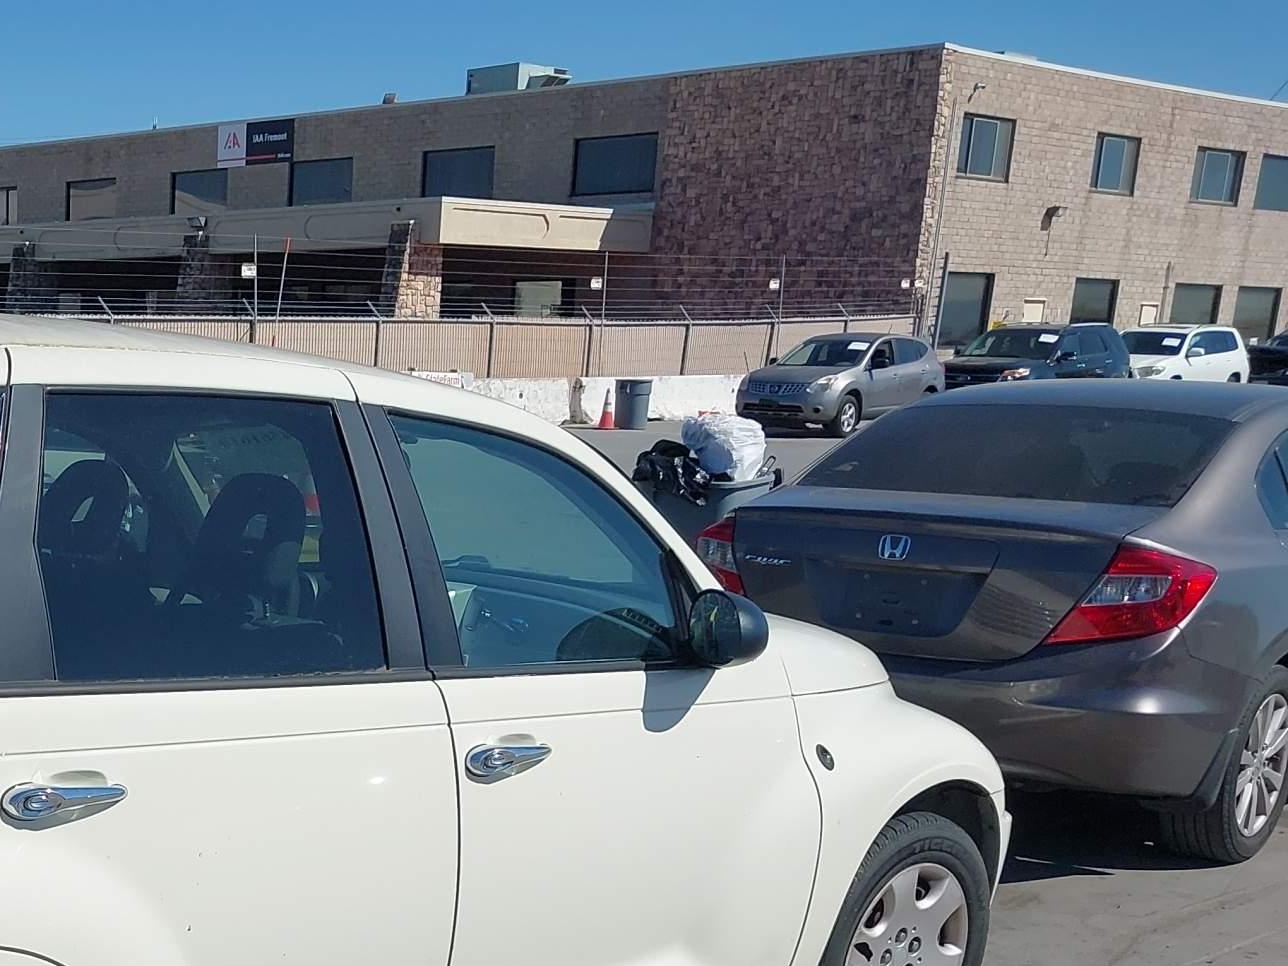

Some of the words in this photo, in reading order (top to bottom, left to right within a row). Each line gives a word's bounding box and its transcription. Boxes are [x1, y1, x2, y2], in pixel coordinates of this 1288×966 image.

[253, 134, 264, 143] IAA
[265, 132, 288, 142] Fremont
[745, 554, 792, 566] CIVIC
